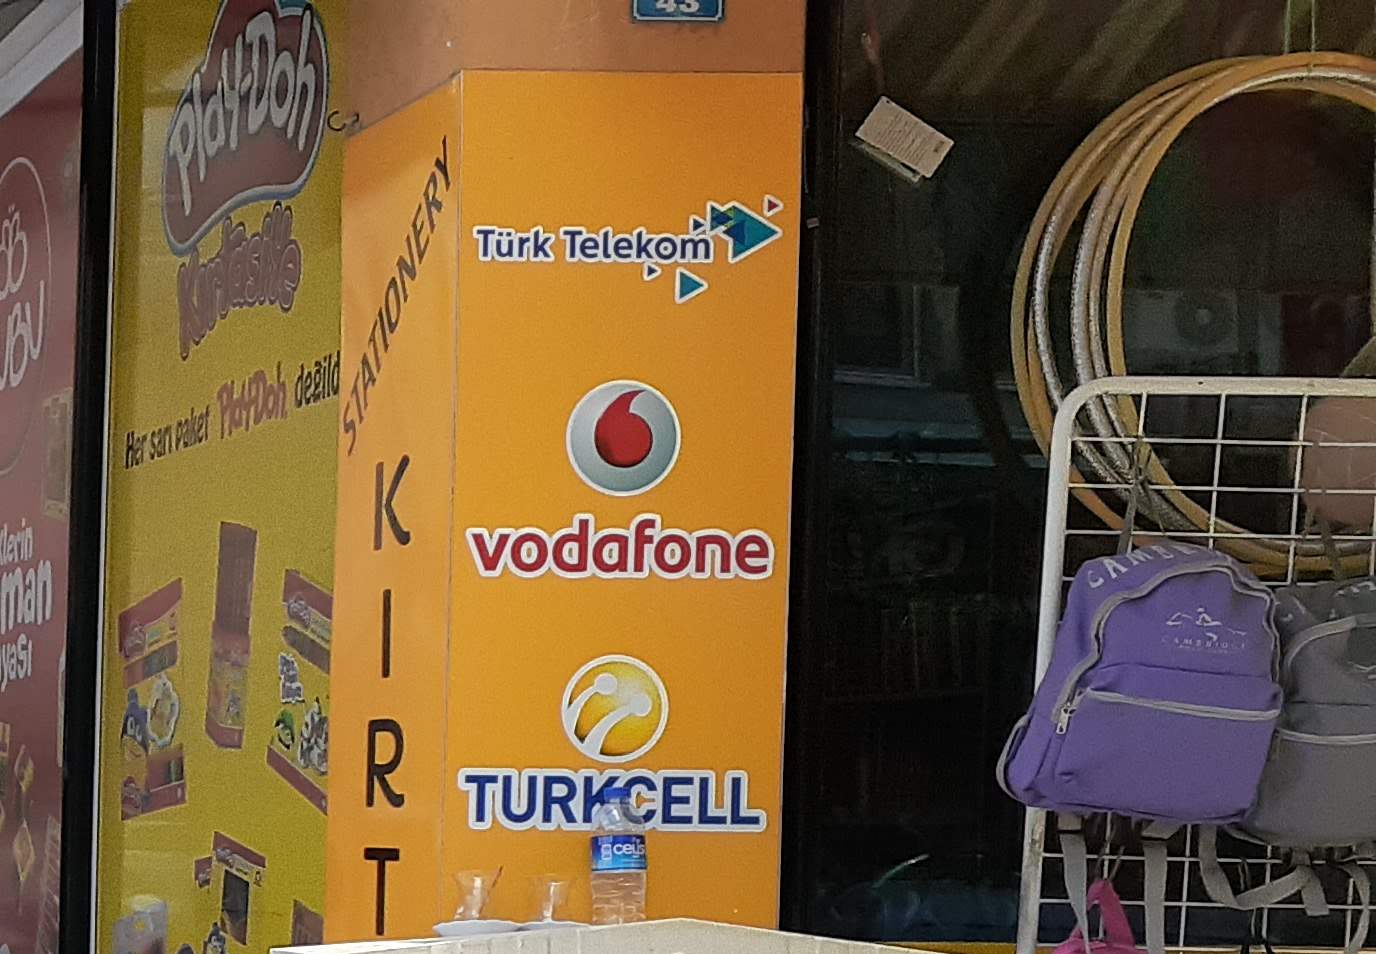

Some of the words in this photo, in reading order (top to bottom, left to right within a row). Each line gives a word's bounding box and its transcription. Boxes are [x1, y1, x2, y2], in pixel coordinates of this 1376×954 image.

[168, 6, 316, 216] Play-Doh
[477, 228, 551, 260] Türk
[564, 228, 711, 261] Telekom
[342, 135, 451, 455] STATIONERY
[124, 430, 147, 469] Her
[175, 404, 210, 453] paket
[470, 517, 770, 576] vodafone
[464, 774, 761, 826] TURKCELL
